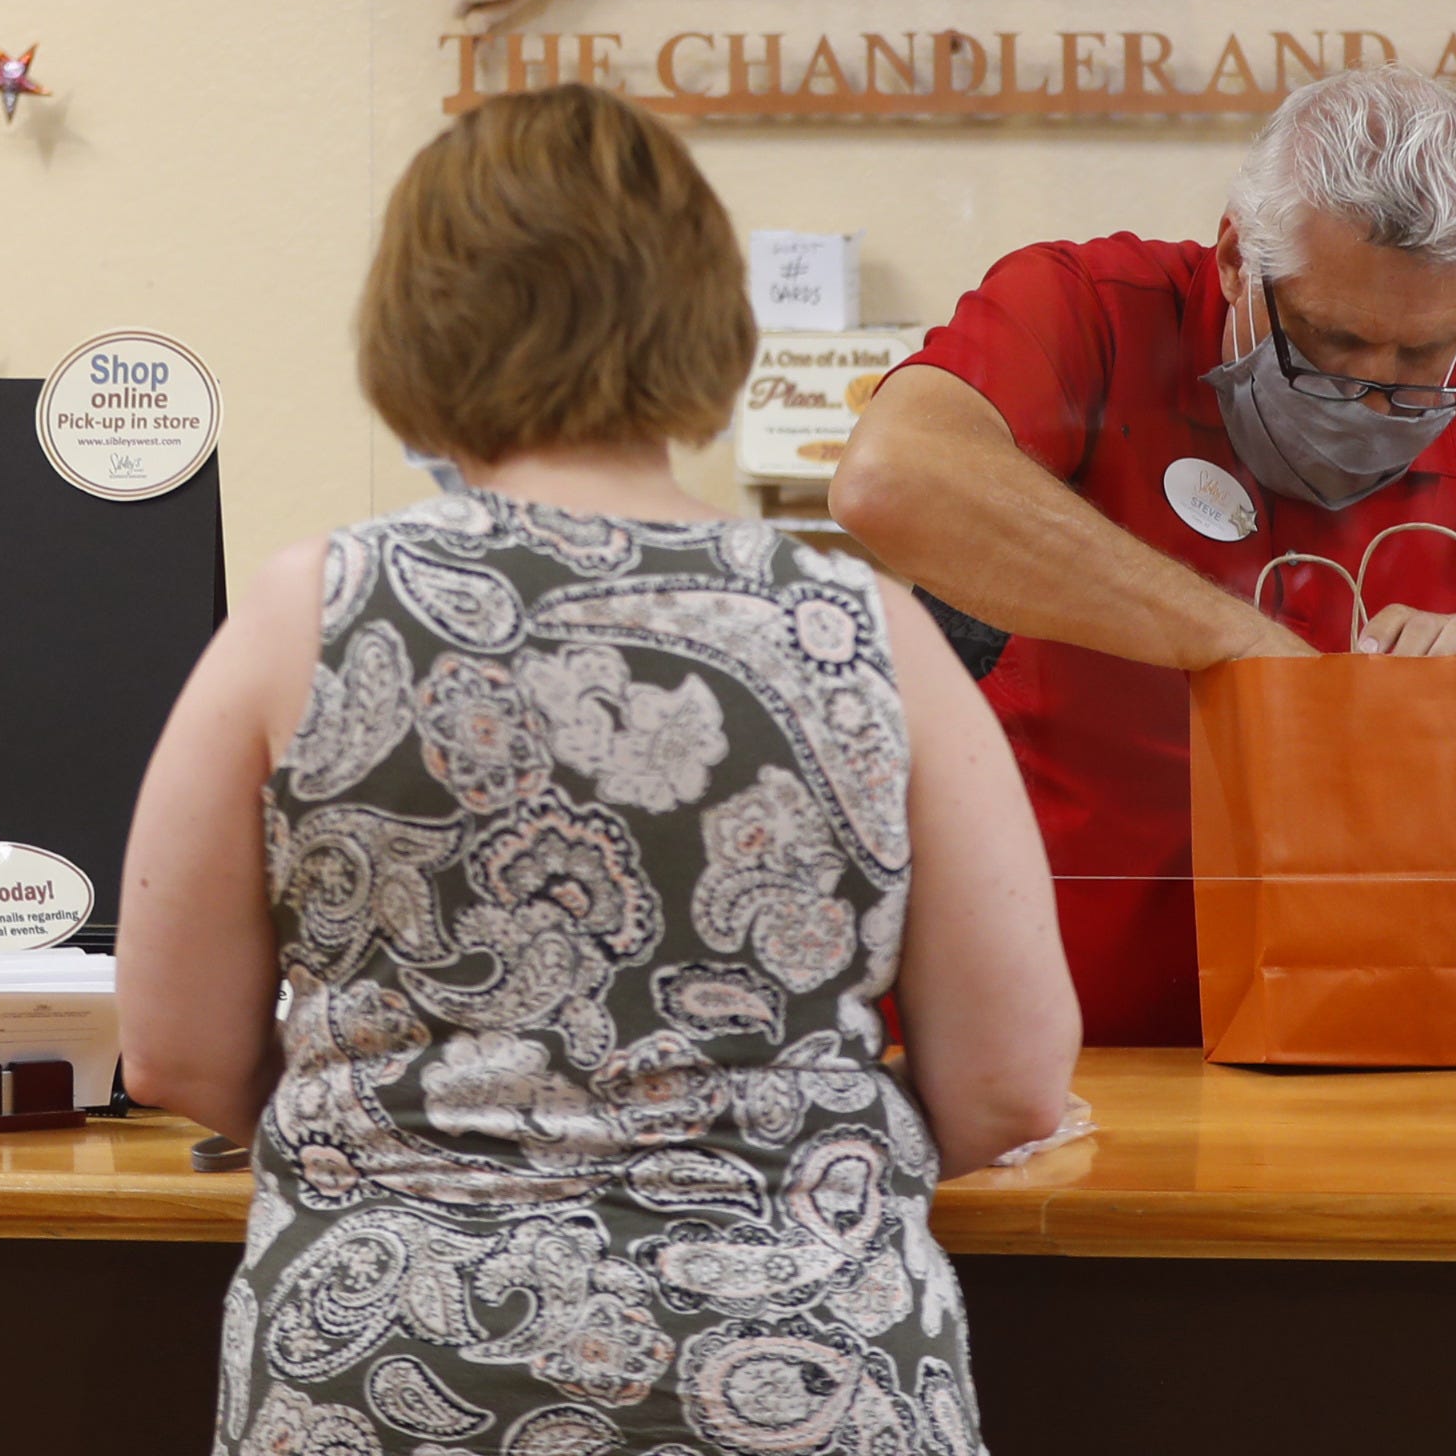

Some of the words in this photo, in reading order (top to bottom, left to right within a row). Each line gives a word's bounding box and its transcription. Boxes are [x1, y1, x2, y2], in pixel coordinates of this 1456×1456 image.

[440, 32, 628, 96] THE
[656, 30, 1184, 96] CHANDLER
[90, 354, 169, 392] Shop
[91, 388, 168, 409] online
[57, 413, 125, 432] Pick-up
[131, 413, 147, 429] in
[153, 415, 200, 429] store
[78, 437, 181, 447] www.sibleyswest.com
[1191, 497, 1223, 520] STEVE
[27, 910, 81, 922] regarding
[10, 927, 48, 936] events.
